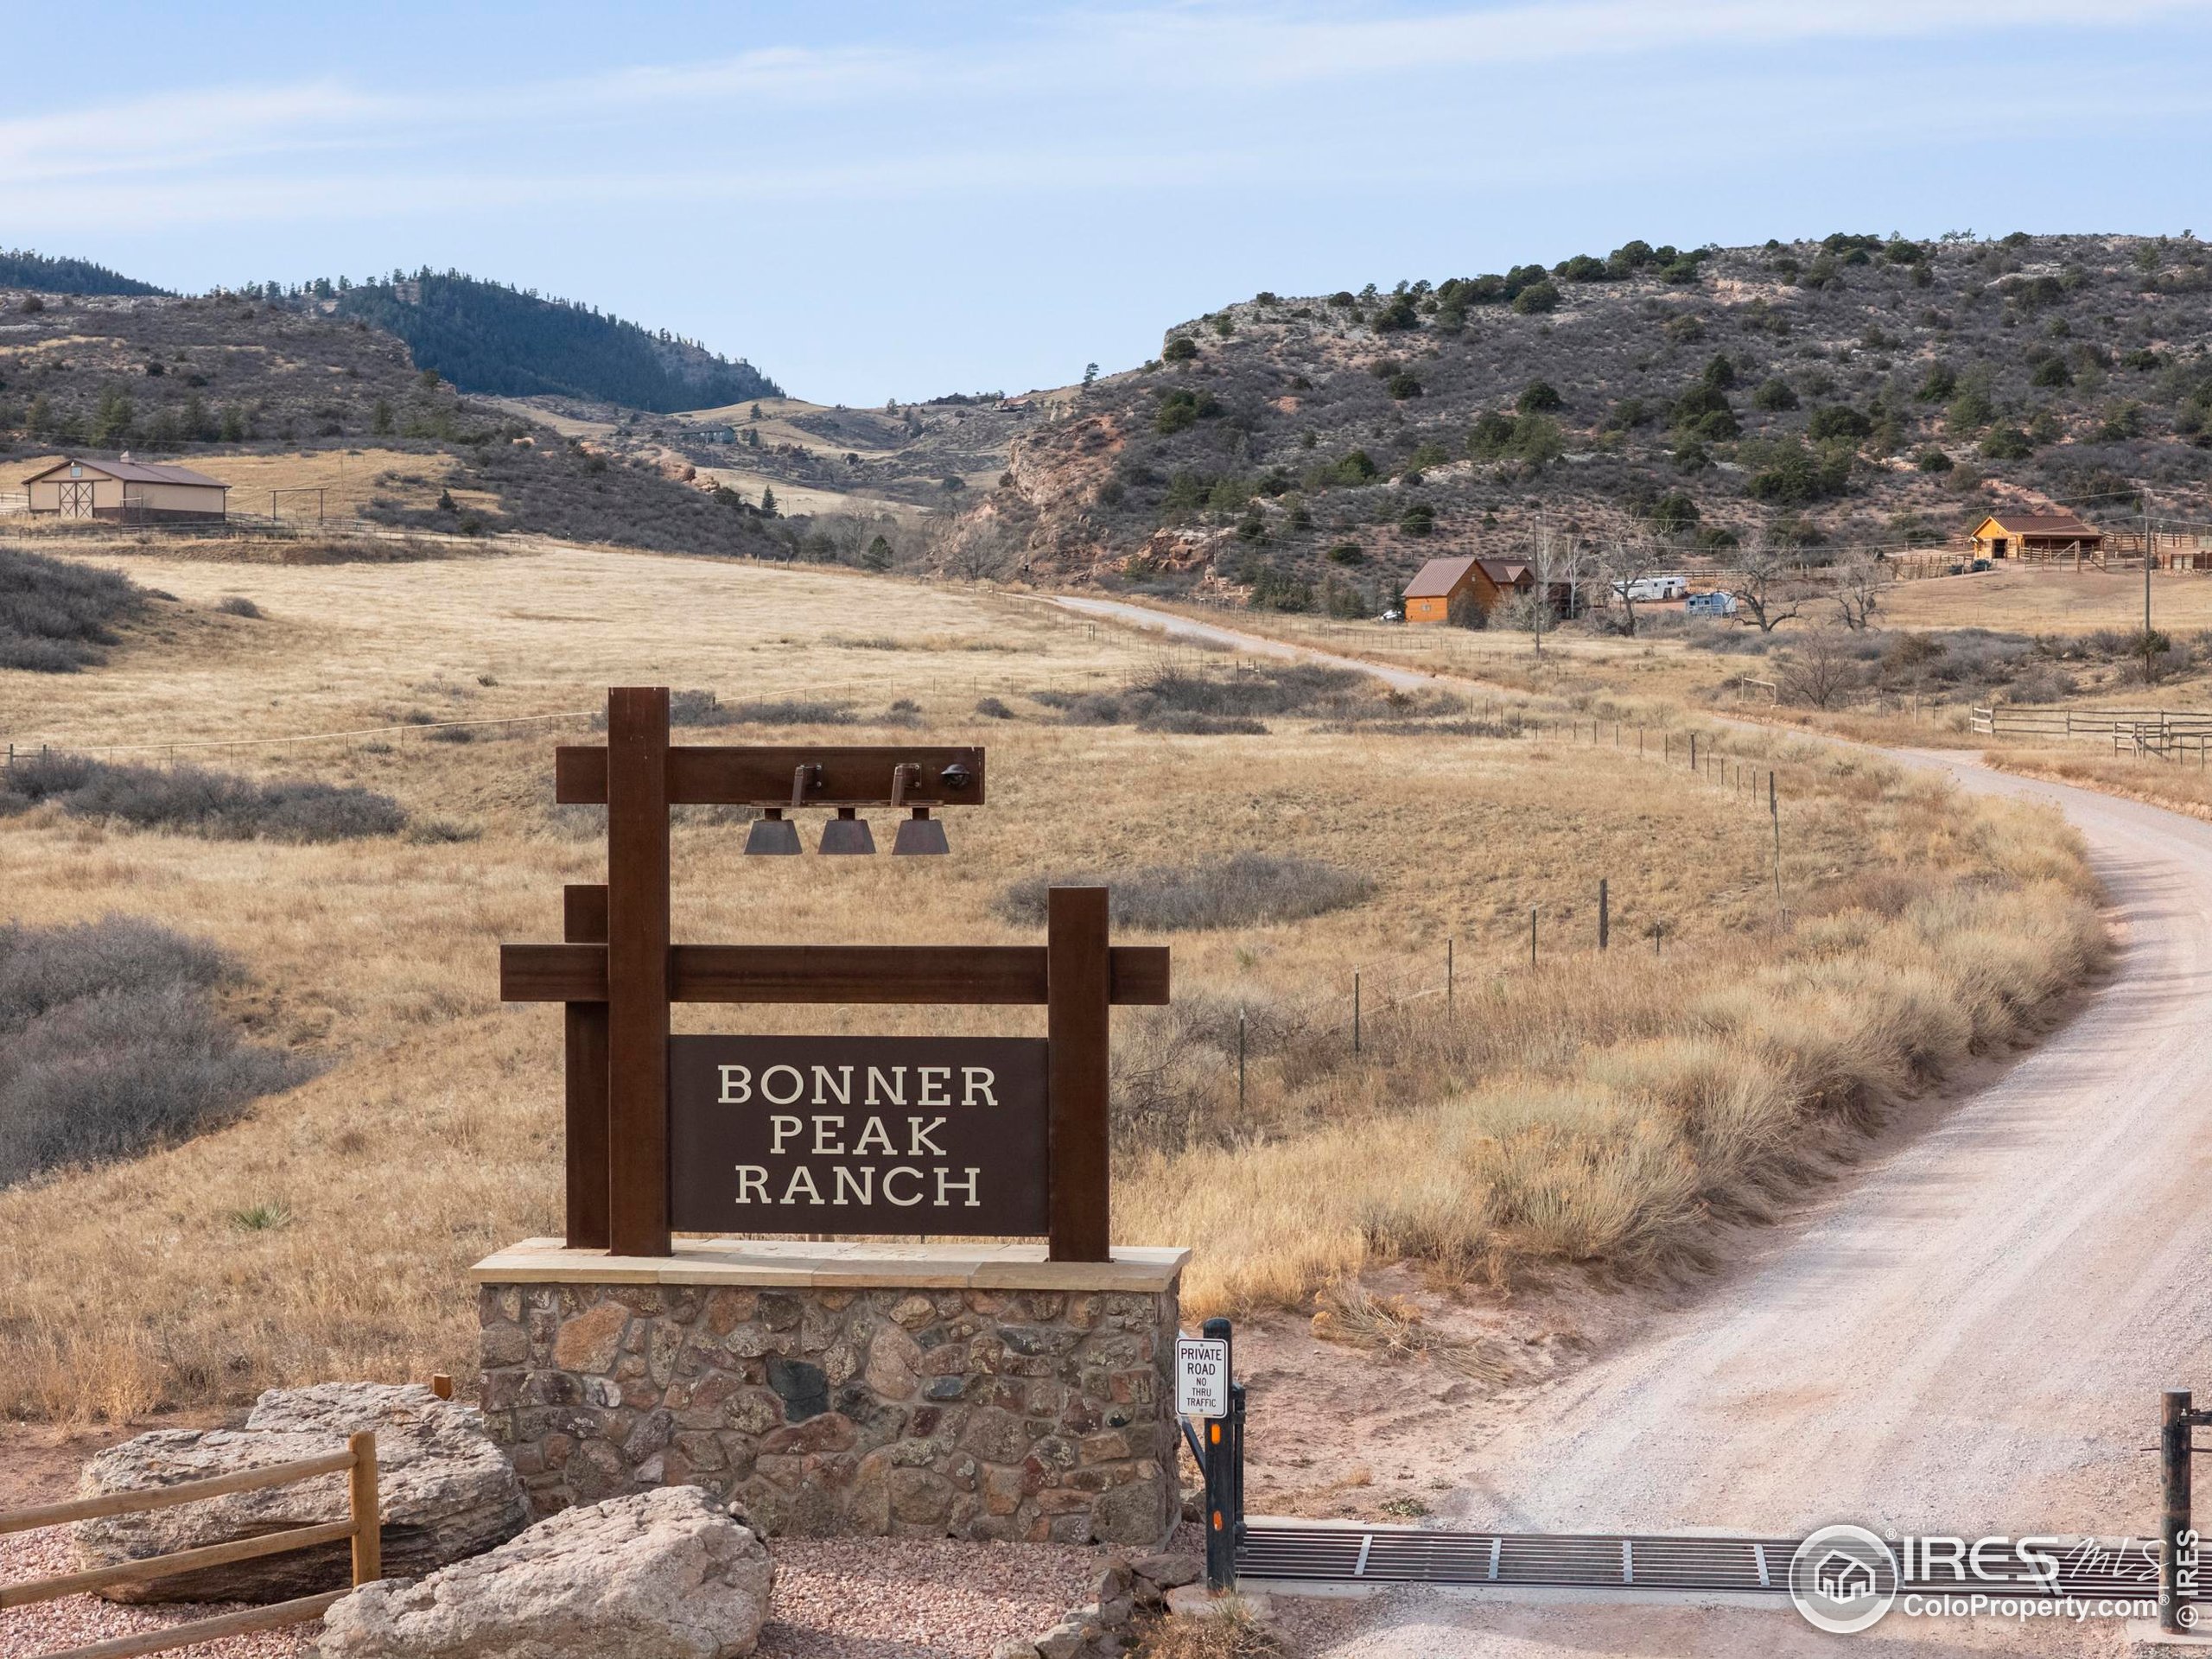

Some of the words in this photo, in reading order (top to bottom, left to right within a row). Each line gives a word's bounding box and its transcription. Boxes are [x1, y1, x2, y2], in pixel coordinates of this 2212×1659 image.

[718, 1065, 998, 1106] BONNER
[770, 1115, 947, 1156] PEAK
[734, 1165, 981, 1207] RANCH
[1180, 1348, 1222, 1361] PRIVATE
[1187, 1363, 1216, 1376] ROAD
[1197, 1377, 1206, 1386] NO
[1192, 1388, 1211, 1396] THRU
[1186, 1398, 1217, 1407] TRAFFIC
